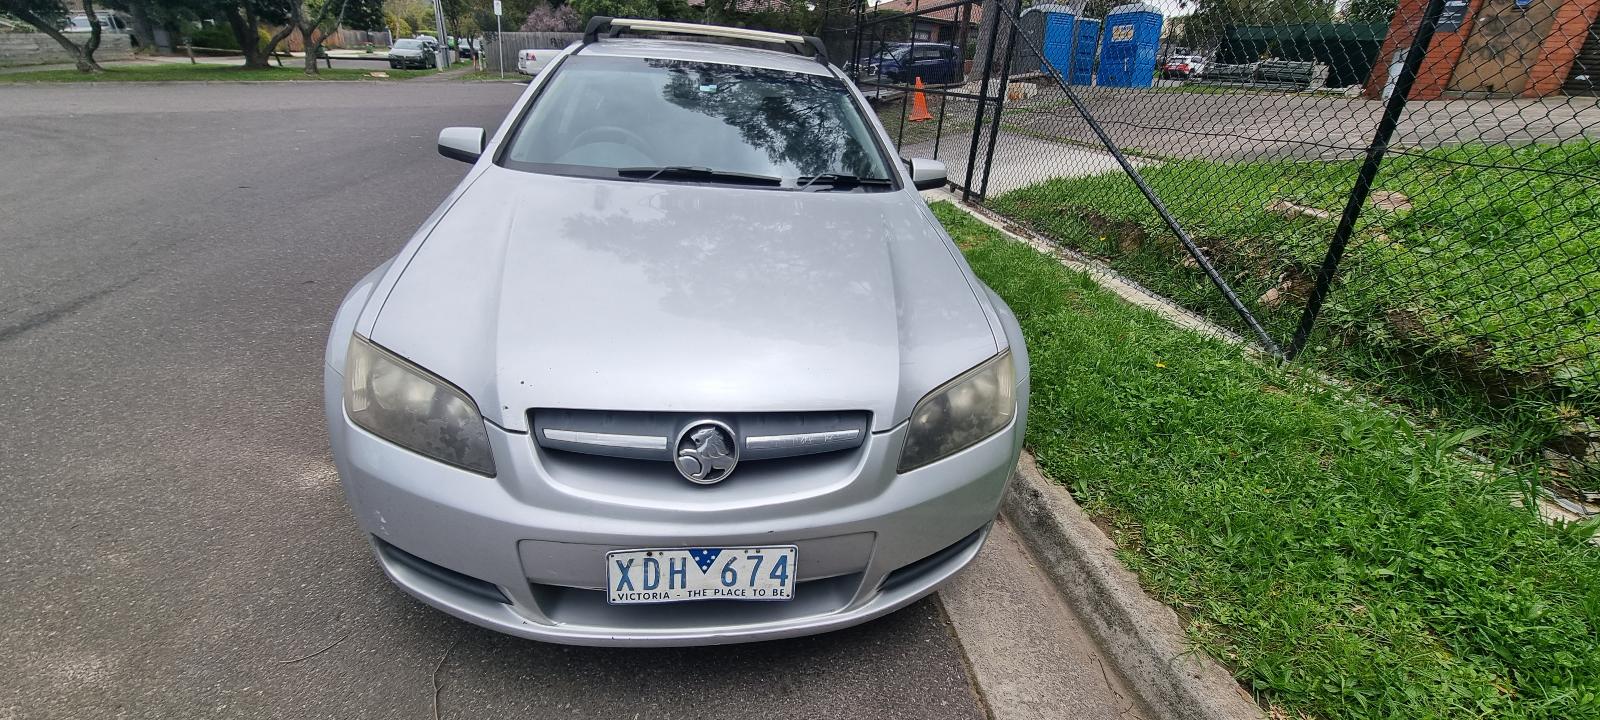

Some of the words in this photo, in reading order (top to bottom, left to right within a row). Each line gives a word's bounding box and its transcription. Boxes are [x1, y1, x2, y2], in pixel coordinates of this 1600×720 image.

[616, 556, 687, 592] XDH
[721, 555, 789, 588] 674
[617, 592, 670, 601] VICTORIA
[687, 589, 707, 598] THE
[714, 588, 746, 597] PLACE
[753, 588, 766, 597] TO
[772, 589, 785, 597] BE
